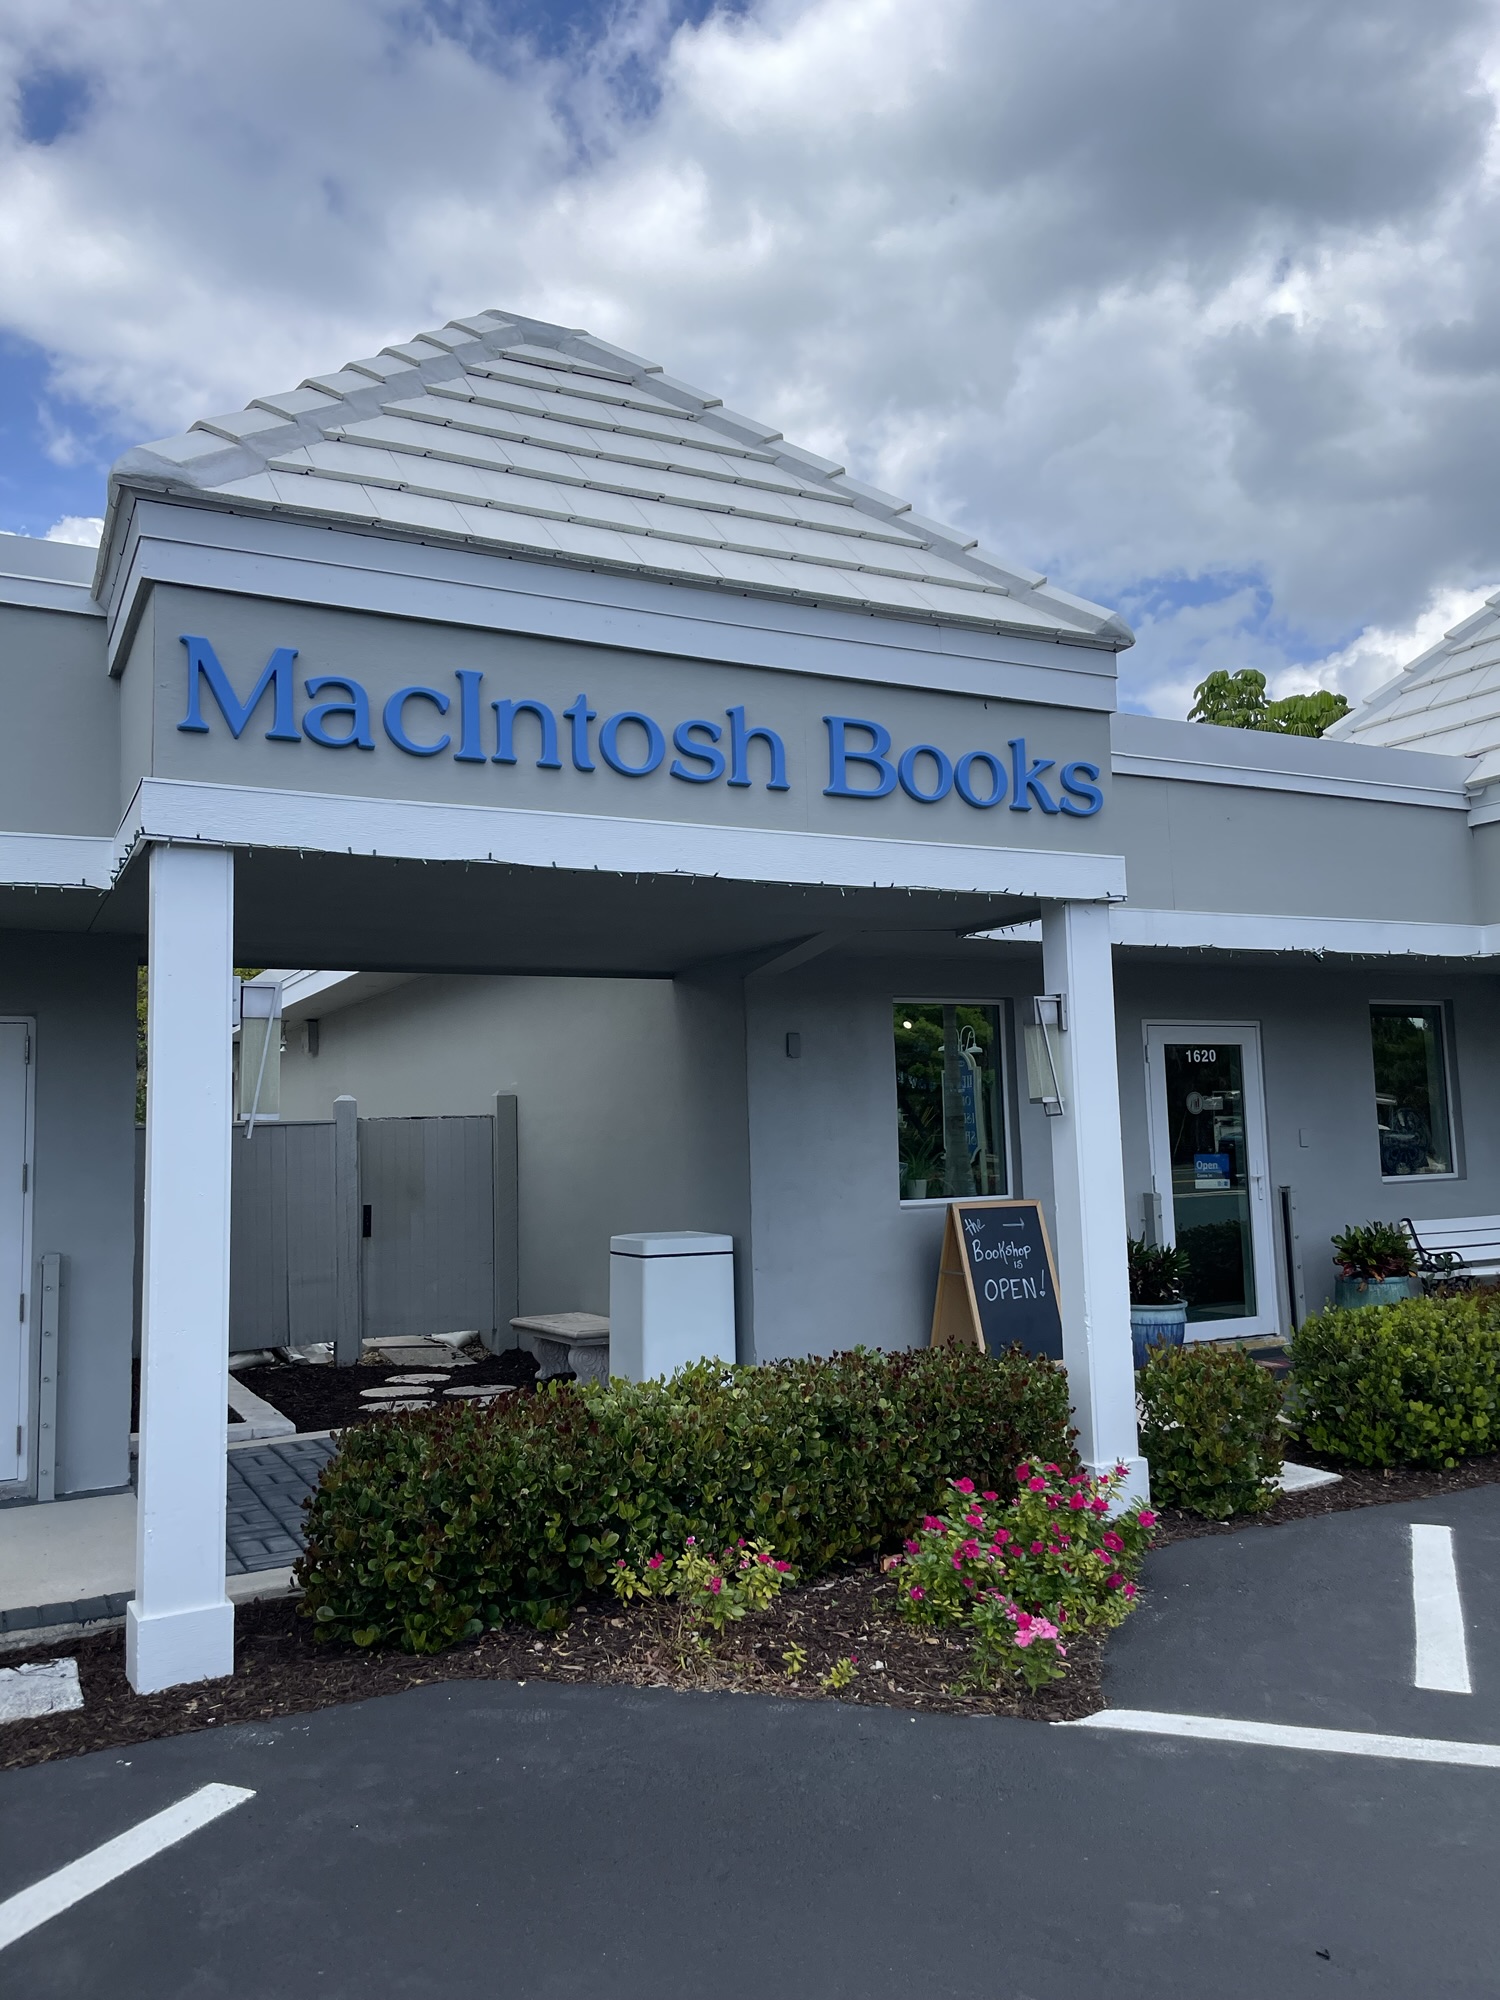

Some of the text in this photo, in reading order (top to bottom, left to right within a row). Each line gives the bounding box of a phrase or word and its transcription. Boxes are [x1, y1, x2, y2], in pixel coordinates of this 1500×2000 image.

[177, 635, 1104, 817] MacIntosh Books
[1185, 1049, 1216, 1063] 1620
[1196, 1160, 1218, 1171] Open
[965, 1218, 986, 1236] the
[971, 1239, 1032, 1265] Bookshop
[1013, 1259, 1024, 1270] is
[984, 1269, 1046, 1302] OPEN!
